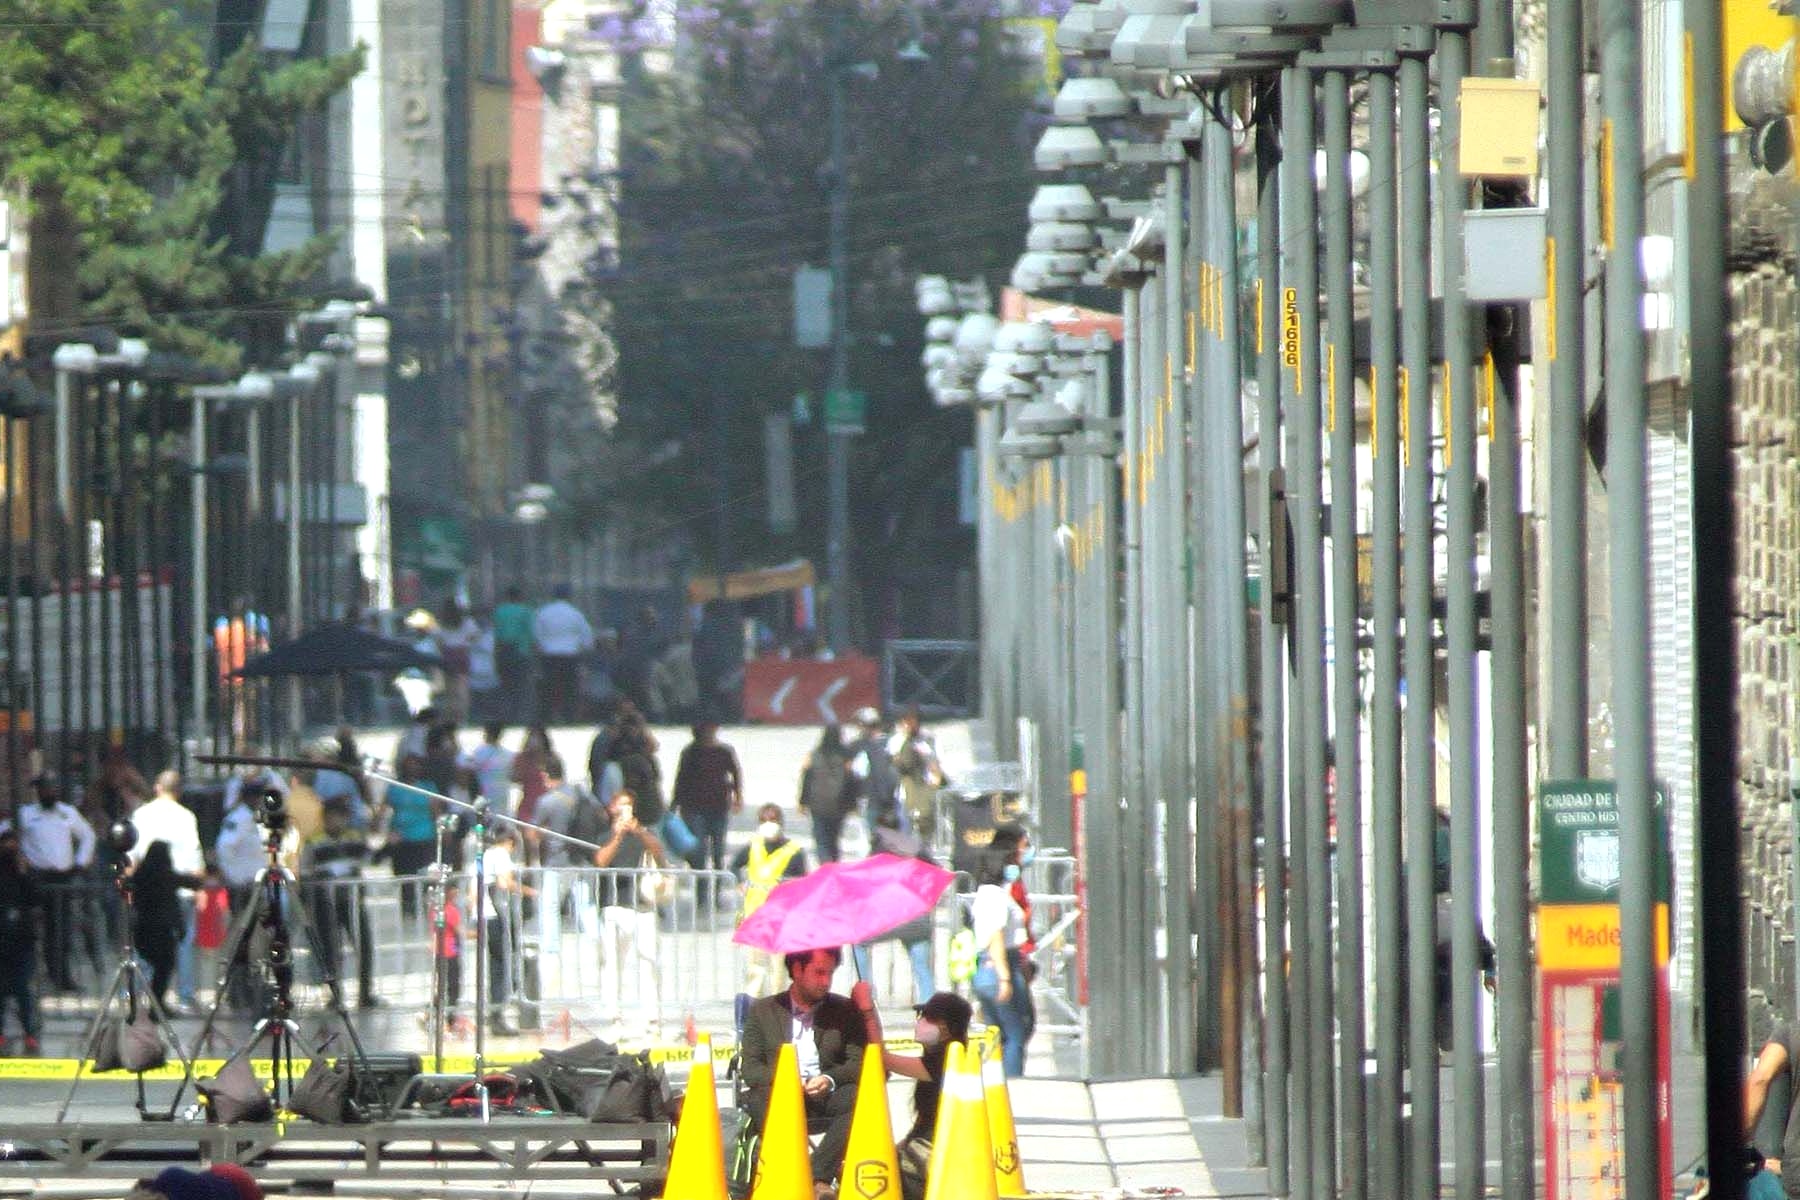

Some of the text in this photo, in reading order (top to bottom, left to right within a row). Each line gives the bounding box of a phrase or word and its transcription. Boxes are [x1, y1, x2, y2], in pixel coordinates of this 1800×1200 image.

[1544, 793, 1592, 809] CIUDAD
[1596, 793, 1612, 806] DE
[1555, 811, 1596, 825] CENTRO
